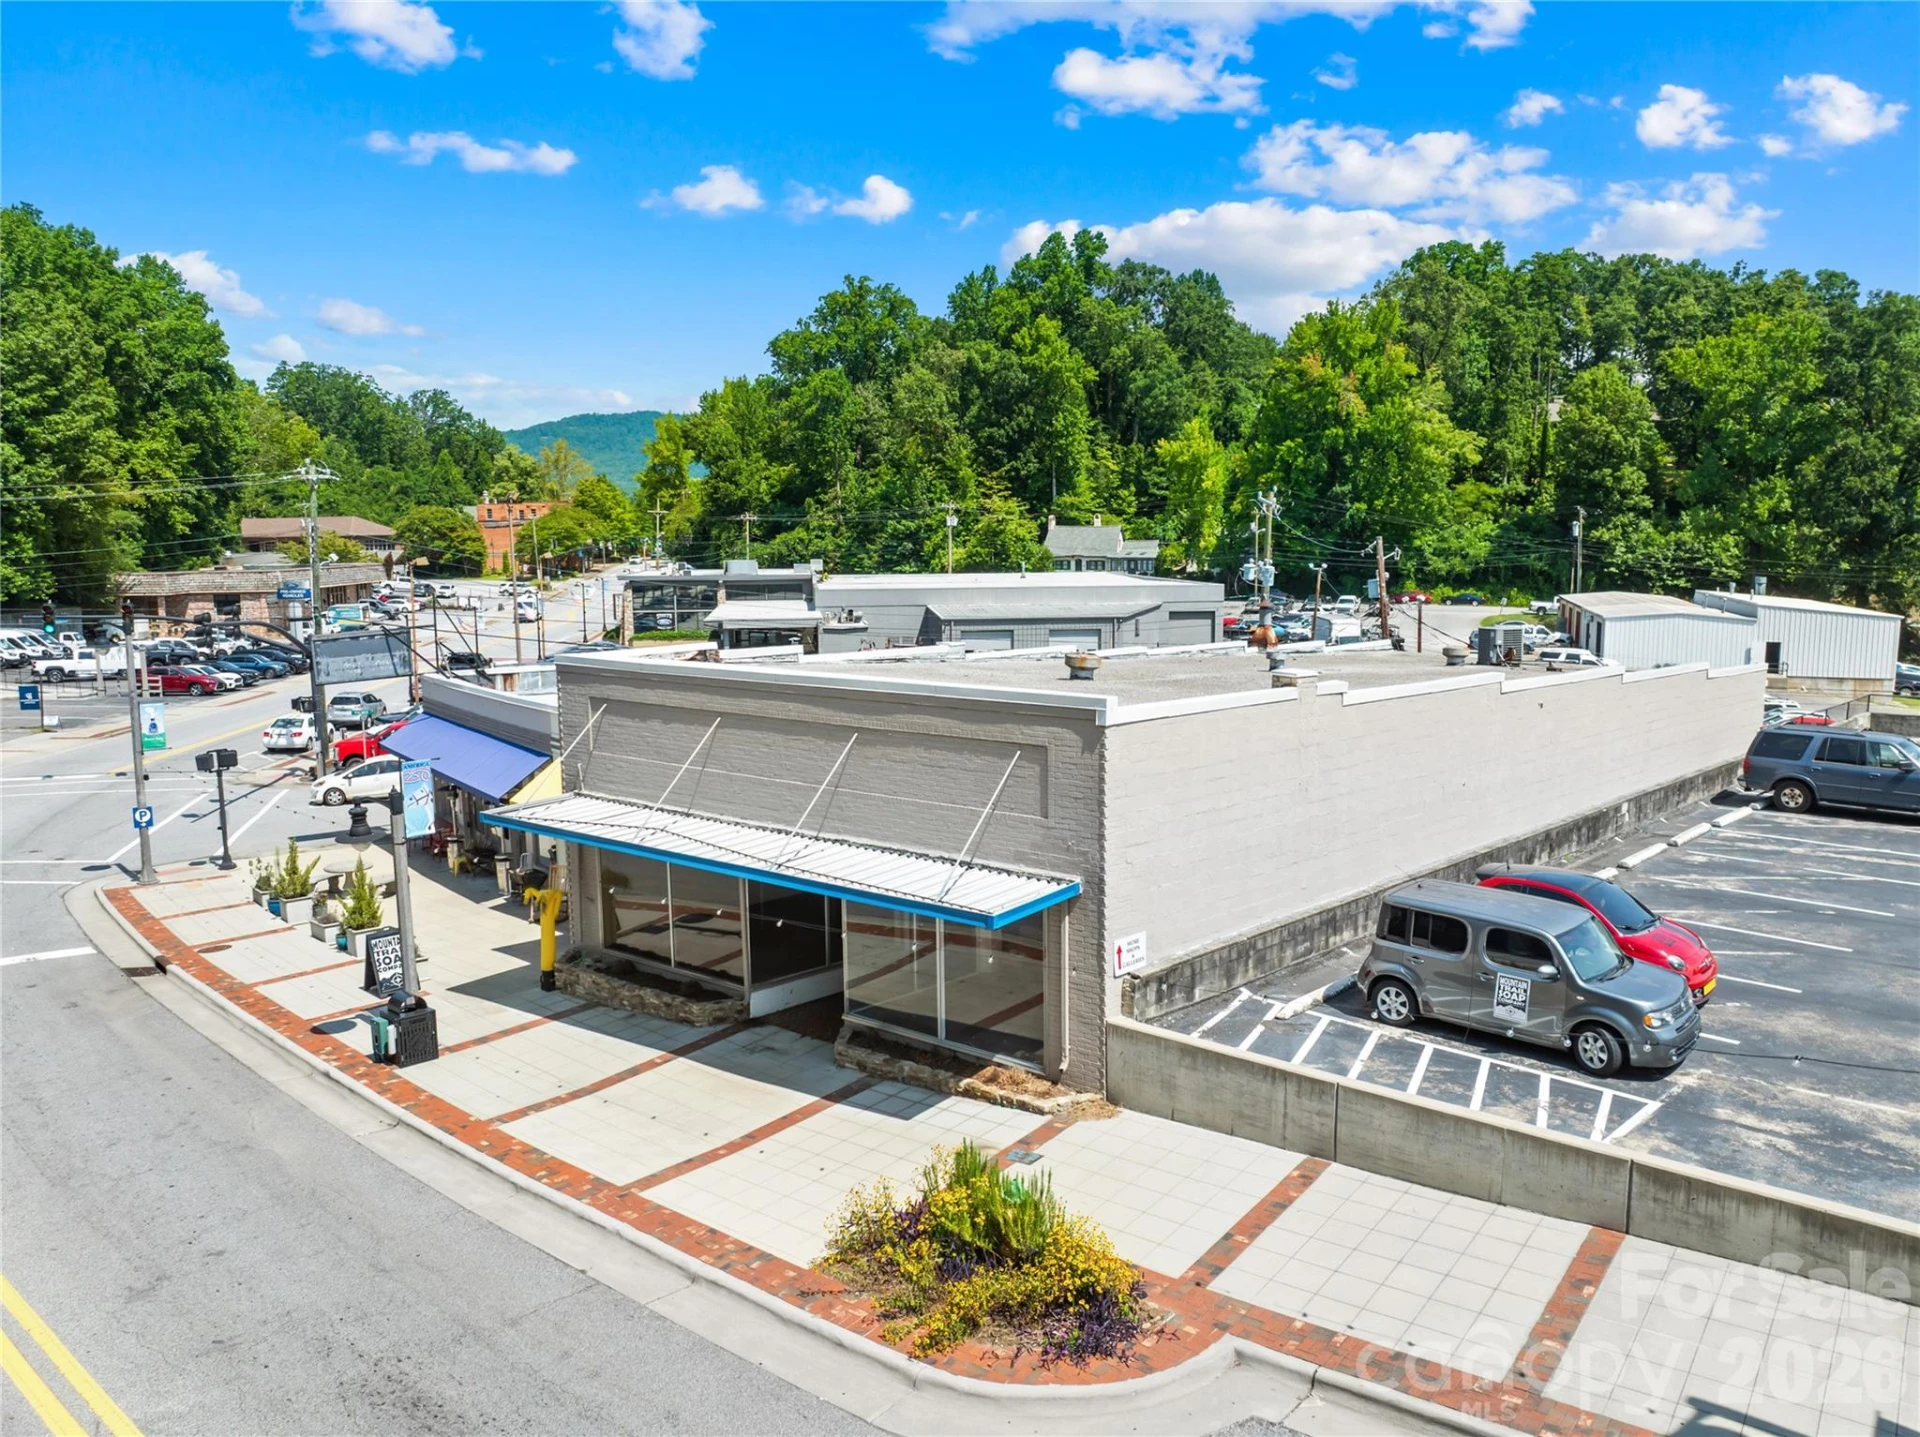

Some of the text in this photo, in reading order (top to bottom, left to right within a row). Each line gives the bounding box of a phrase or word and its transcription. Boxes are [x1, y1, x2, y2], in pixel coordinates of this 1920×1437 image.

[404, 761, 430, 769] AMERICA
[404, 769, 431, 783] 250
[139, 811, 147, 820] P
[372, 936, 400, 950] MOUNTA
[374, 947, 399, 957] TRA
[376, 954, 402, 967] SOA
[1500, 976, 1528, 990] MOUNTAIN
[1500, 984, 1526, 995] TRAIL
[1498, 990, 1526, 1002] SOAP
[1498, 997, 1525, 1006] COMPANY
